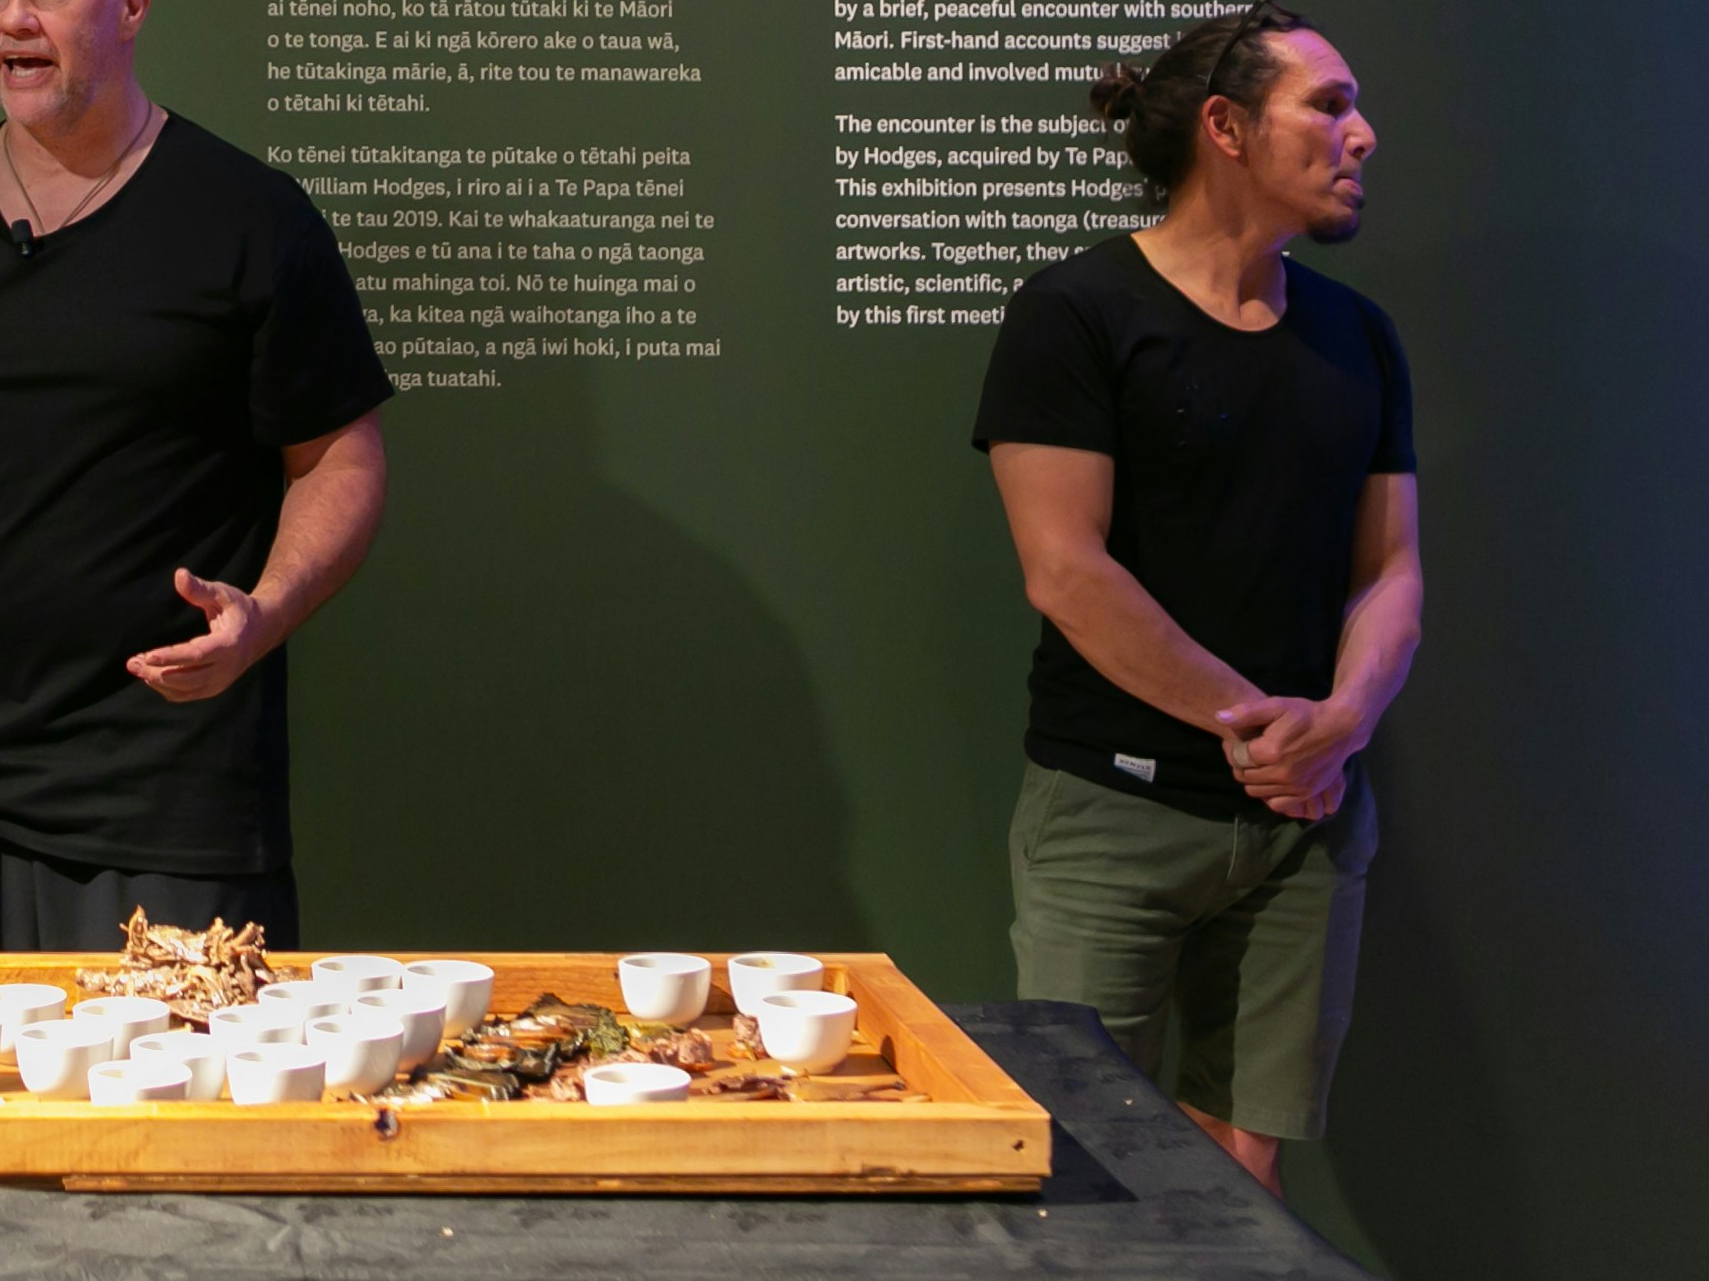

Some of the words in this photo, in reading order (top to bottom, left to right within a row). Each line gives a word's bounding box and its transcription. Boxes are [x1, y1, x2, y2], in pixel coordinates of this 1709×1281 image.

[454, 0, 506, 18] rātou
[572, 0, 589, 18] ki
[593, 1, 614, 18] te
[619, 0, 673, 19] Māori
[862, 2, 876, 18] a
[1020, 0, 1121, 19] encounter
[834, 29, 895, 50] Māori.
[900, 29, 1000, 51] First-hand
[1003, 32, 1093, 51] accounts
[1096, 32, 1172, 55] suggest
[267, 61, 291, 80] he
[295, 61, 388, 85] tūtakinga
[392, 61, 453, 84] mārie,
[457, 62, 475, 84] ā,
[480, 62, 514, 82] rite
[517, 64, 551, 82] tou
[555, 64, 576, 82] te
[580, 62, 702, 82] manawareka
[834, 61, 923, 82] amicable
[926, 61, 964, 82] and
[968, 61, 1050, 82] involved
[834, 113, 873, 134] The
[876, 116, 977, 134] encounter
[979, 113, 997, 135] is
[999, 113, 1034, 135] the
[267, 145, 293, 164] Ko
[297, 144, 346, 164] tēnei
[350, 144, 463, 169] tūtakitanga
[465, 147, 487, 165] te
[491, 145, 558, 169] pūtake
[562, 150, 575, 165] o
[579, 146, 637, 166] tētahi
[642, 146, 692, 170] peita
[835, 145, 860, 170] by
[863, 145, 943, 171] Hodges,
[946, 145, 1032, 170] acquired
[1036, 145, 1061, 171] by
[1064, 146, 1088, 167] Te
[1092, 146, 1134, 170] Pap
[373, 176, 452, 200] Hodges,
[456, 177, 462, 196] i
[467, 177, 501, 197] riro
[505, 177, 523, 197] ai
[528, 177, 534, 197] i
[538, 182, 551, 197] a
[554, 178, 578, 197] Te
[583, 178, 631, 201] Papa
[635, 178, 684, 198] tēnei
[834, 176, 878, 198] This
[881, 177, 978, 198] exhibition
[982, 179, 1067, 202] presents
[835, 209, 961, 230] conversation
[964, 209, 1007, 230] with
[1010, 211, 1079, 234] taonga
[835, 240, 927, 262] artworks.
[930, 240, 1022, 266] Together,
[392, 272, 475, 296] mahinga
[478, 273, 511, 292] toi.
[516, 273, 544, 292] Nō
[547, 275, 569, 292] te
[573, 273, 639, 297] huinga
[643, 273, 679, 293] mai
[683, 278, 697, 293] o
[835, 272, 911, 296] artistic,
[914, 272, 1009, 296] scientific,
[836, 304, 861, 329] by
[864, 304, 902, 325] this
[905, 304, 947, 326] first
[950, 304, 1005, 326] meeti
[426, 368, 502, 388] tuatahi.
